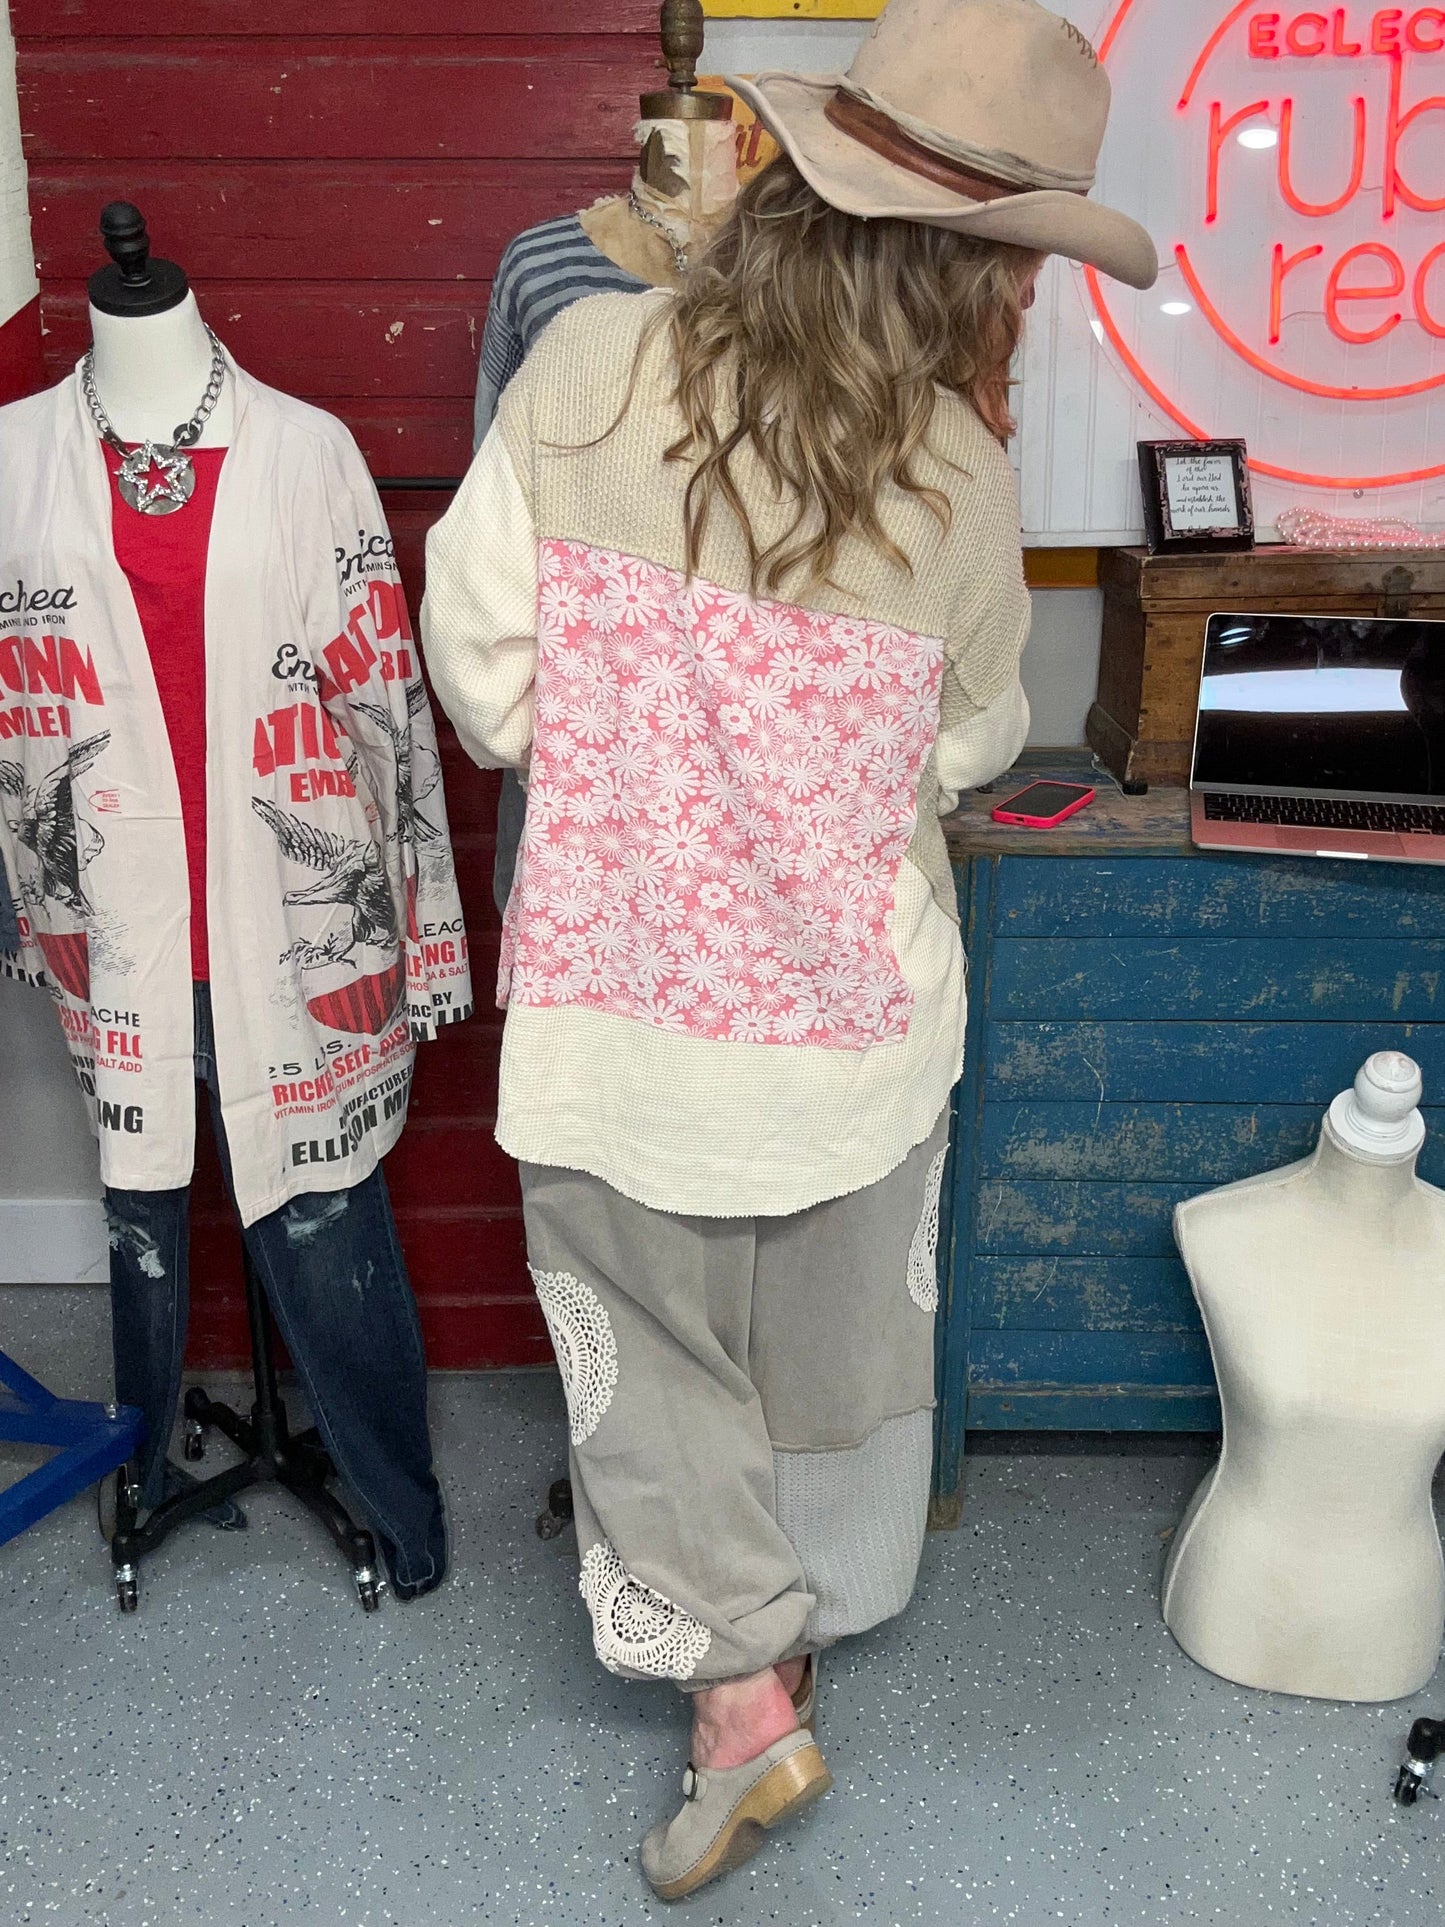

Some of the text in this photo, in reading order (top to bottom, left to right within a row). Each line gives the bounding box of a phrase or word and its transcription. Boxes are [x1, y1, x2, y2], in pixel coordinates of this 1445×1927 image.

[1248, 8, 1445, 59] ECLEC
[42, 614, 66, 625] IRON
[431, 991, 453, 1007] BY
[118, 1060, 143, 1073] ADD
[274, 1105, 315, 1121] VITAMIN
